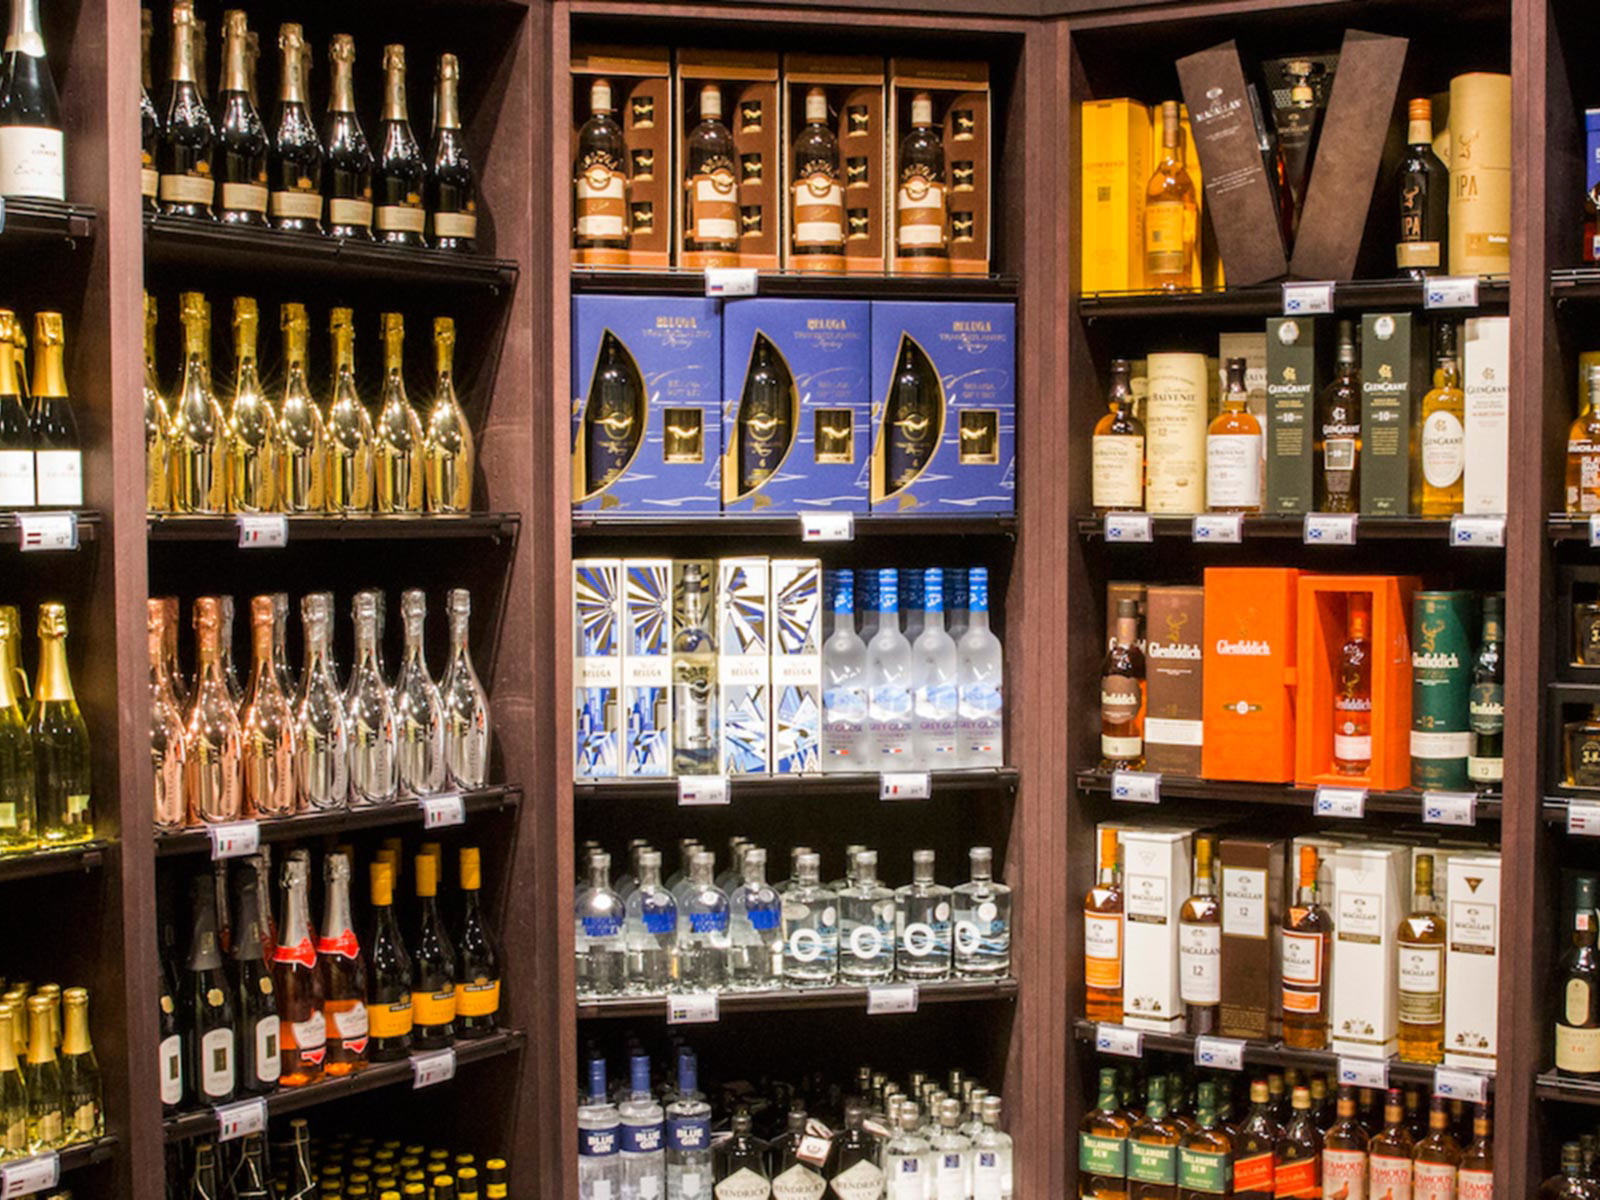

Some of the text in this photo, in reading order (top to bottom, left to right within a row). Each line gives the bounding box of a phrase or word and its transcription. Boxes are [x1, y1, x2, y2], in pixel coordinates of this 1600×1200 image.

[1456, 175, 1478, 198] IPA
[1421, 716, 1434, 729] 12
[1239, 907, 1248, 917] 12
[1192, 965, 1204, 976] 12
[635, 1130, 660, 1141] BLUE
[676, 1128, 703, 1138] BLUE
[588, 1134, 614, 1146] BLUE
[640, 1140, 658, 1149] GIN
[681, 1137, 700, 1146] GIN
[592, 1144, 611, 1153] GIN
